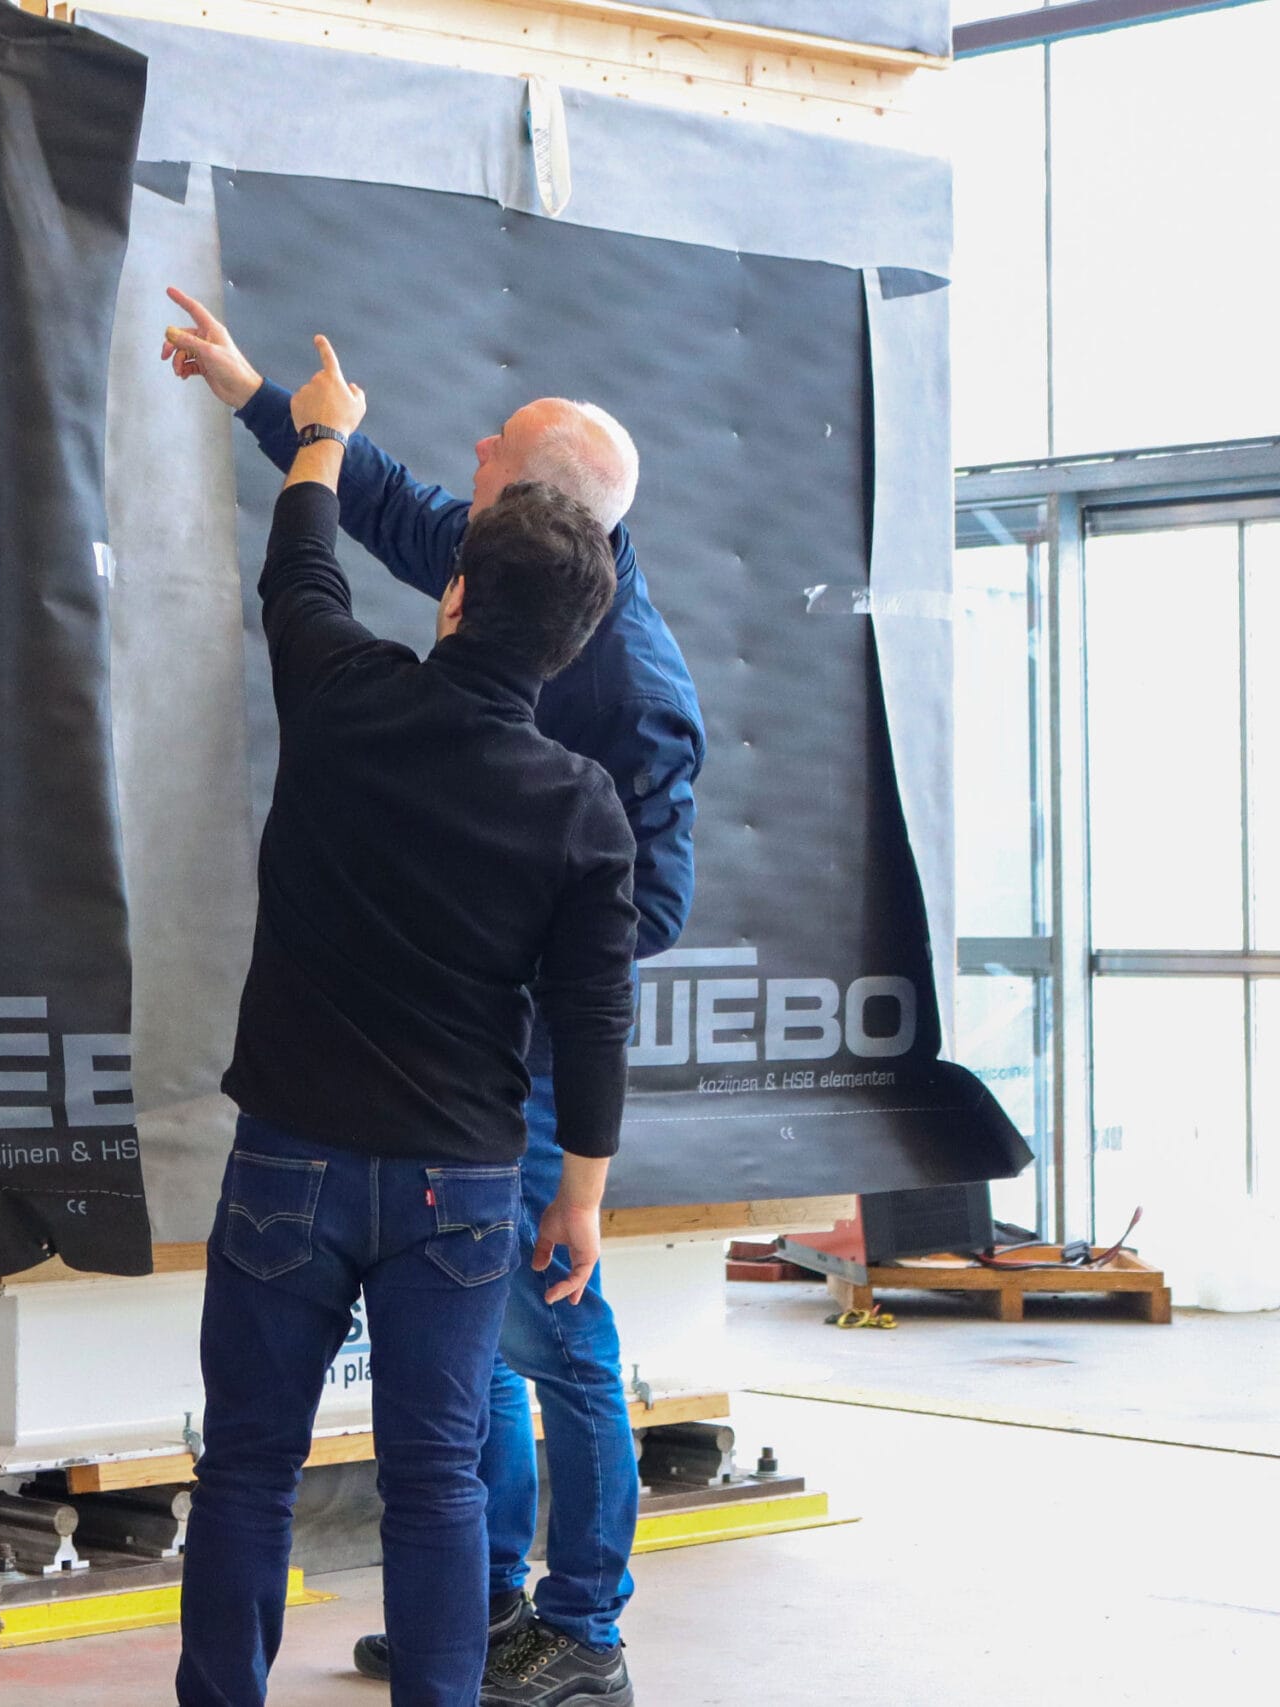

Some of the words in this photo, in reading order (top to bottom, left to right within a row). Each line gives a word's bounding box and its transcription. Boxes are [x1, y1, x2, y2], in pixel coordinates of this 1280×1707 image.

[627, 976, 917, 1067] WEBO
[698, 1074, 758, 1095] kozijnen
[765, 1072, 777, 1091] &
[783, 1071, 815, 1089] HSB
[820, 1069, 896, 1088] elementen
[71, 1140, 92, 1163] &
[101, 1138, 139, 1161] HS
[344, 1356, 373, 1390] pla
